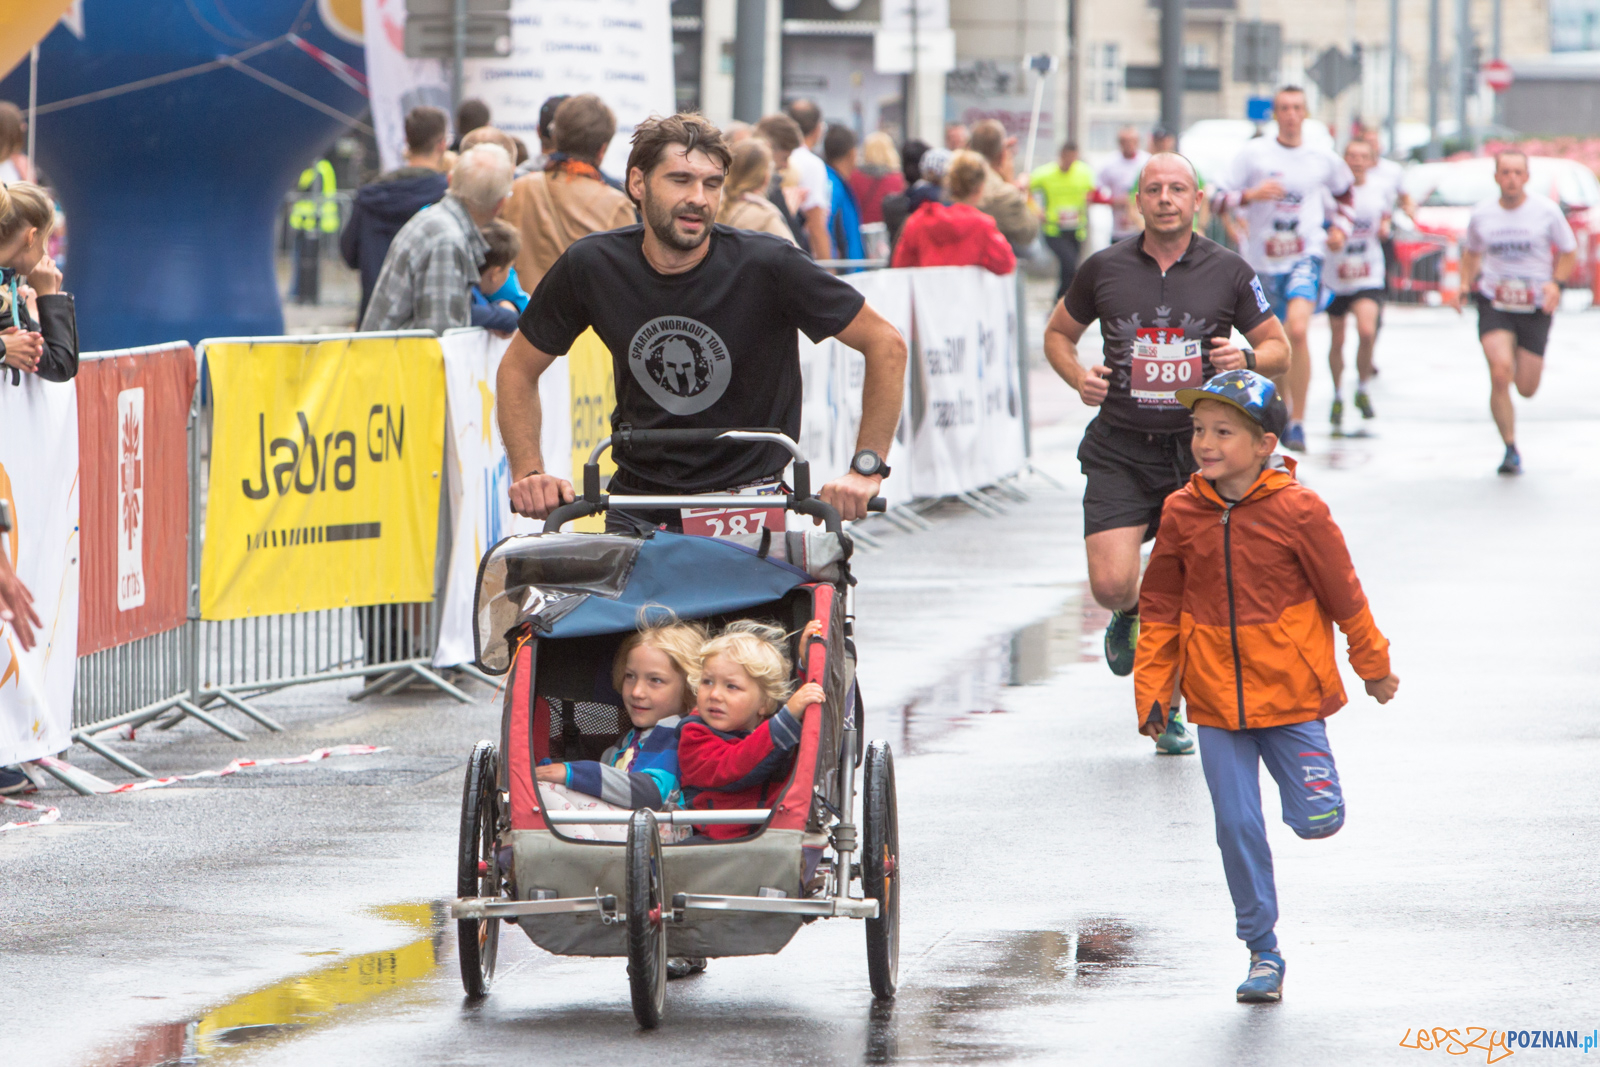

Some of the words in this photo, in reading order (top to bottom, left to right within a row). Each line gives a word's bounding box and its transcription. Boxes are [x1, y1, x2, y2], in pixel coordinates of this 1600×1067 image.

[632, 323, 660, 360] SPARTAN
[658, 319, 709, 339] WORKOUT
[706, 335, 726, 361] TOUR
[1145, 361, 1192, 383] 980
[242, 412, 356, 500] Jabra
[367, 404, 405, 462] GN
[705, 511, 767, 537] 287
